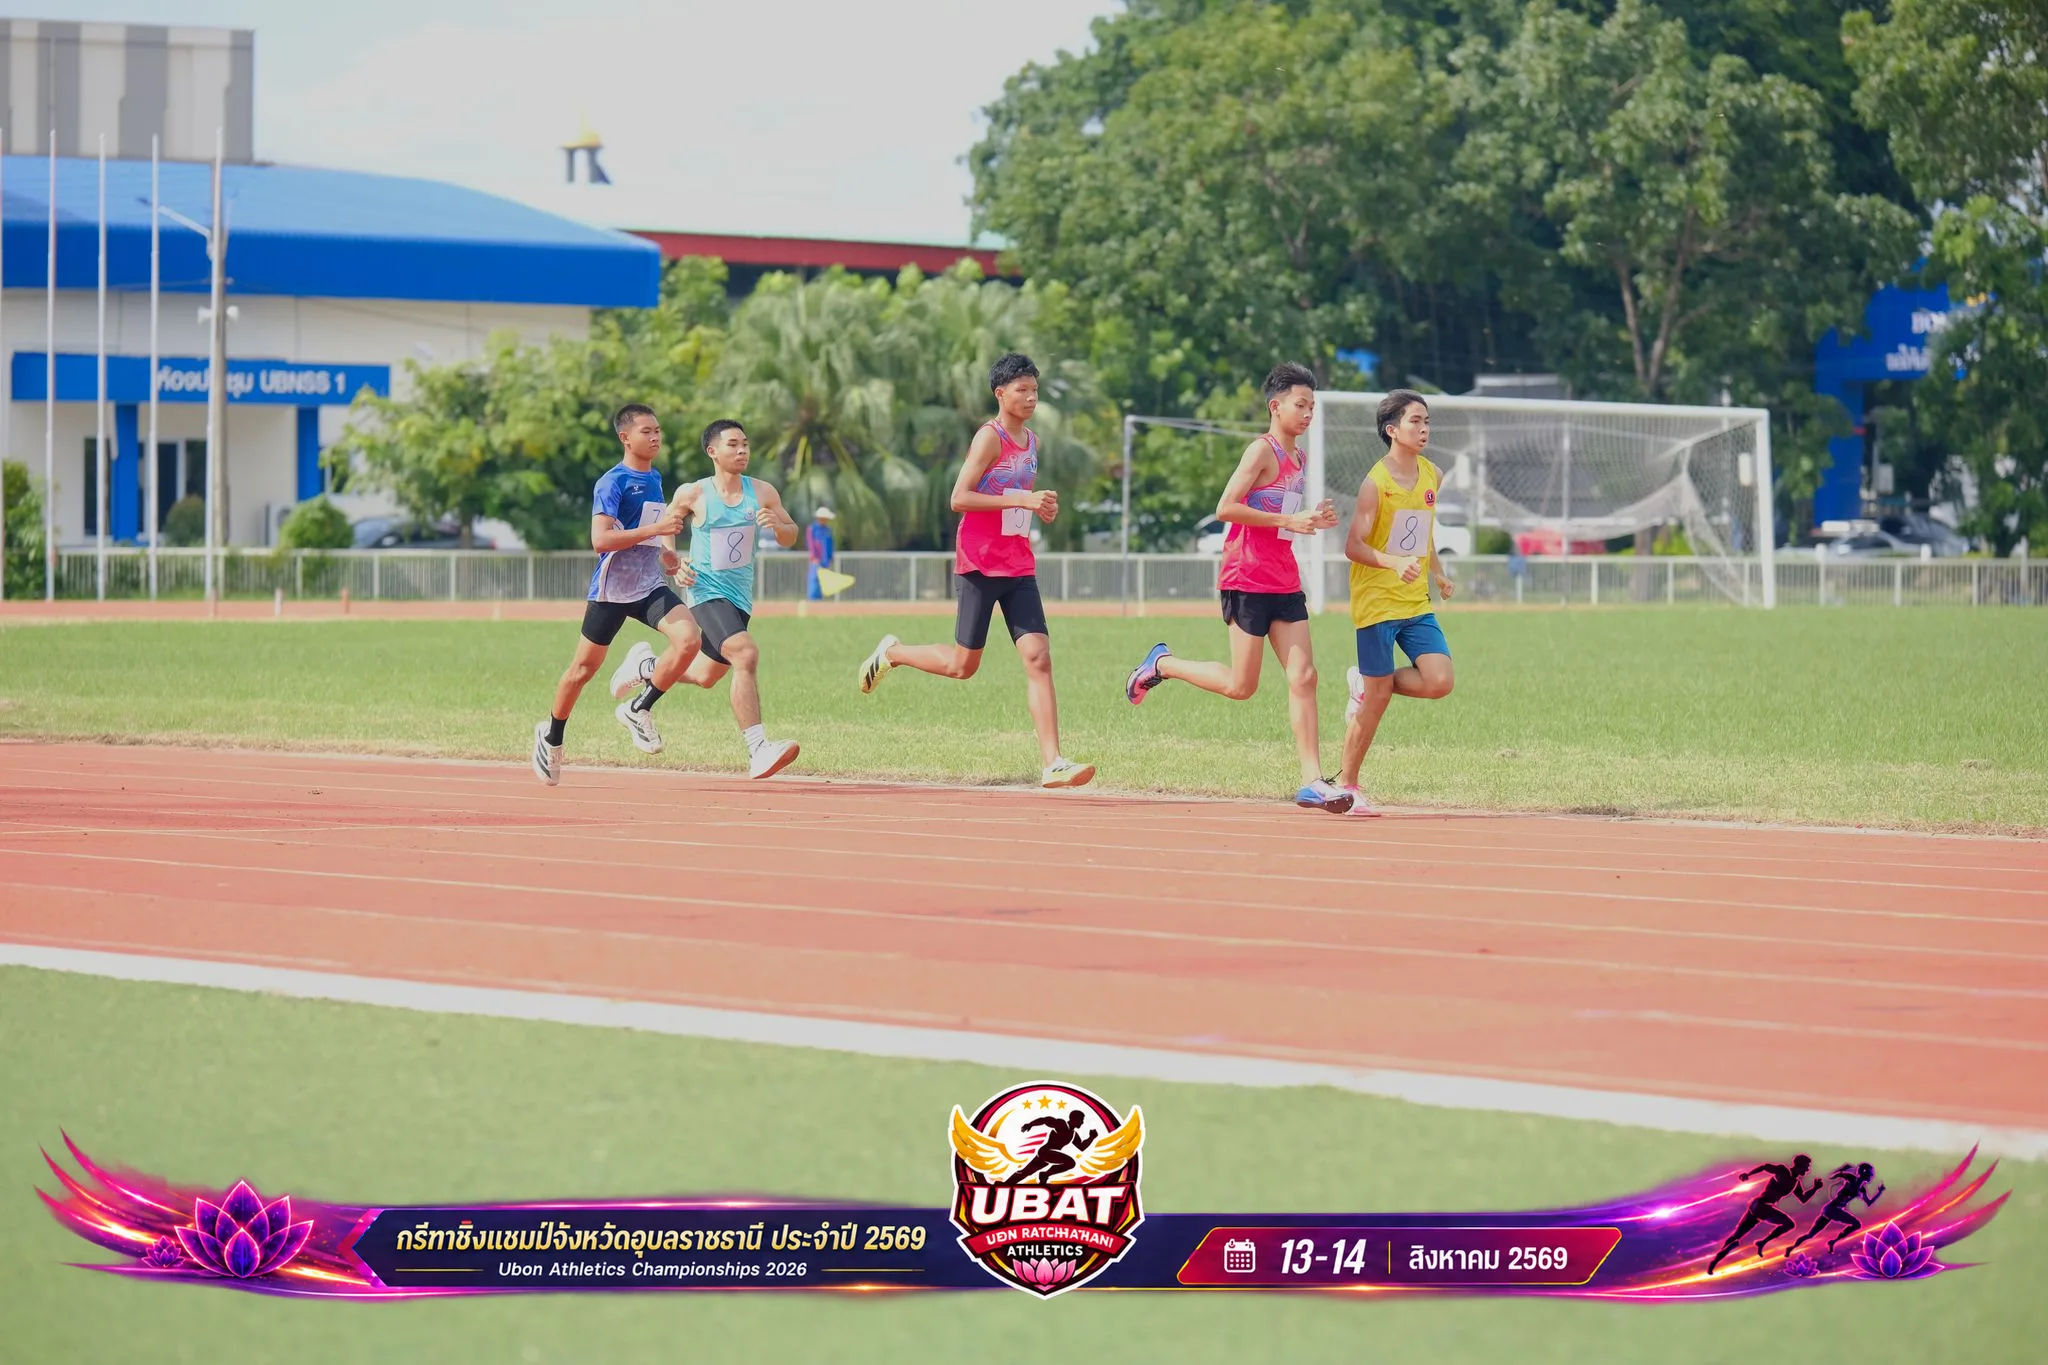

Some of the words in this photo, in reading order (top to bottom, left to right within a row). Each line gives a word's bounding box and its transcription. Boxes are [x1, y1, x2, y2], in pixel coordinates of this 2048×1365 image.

[334, 371, 346, 395] 1
[727, 531, 744, 563] 8
[1400, 516, 1418, 550] 8
